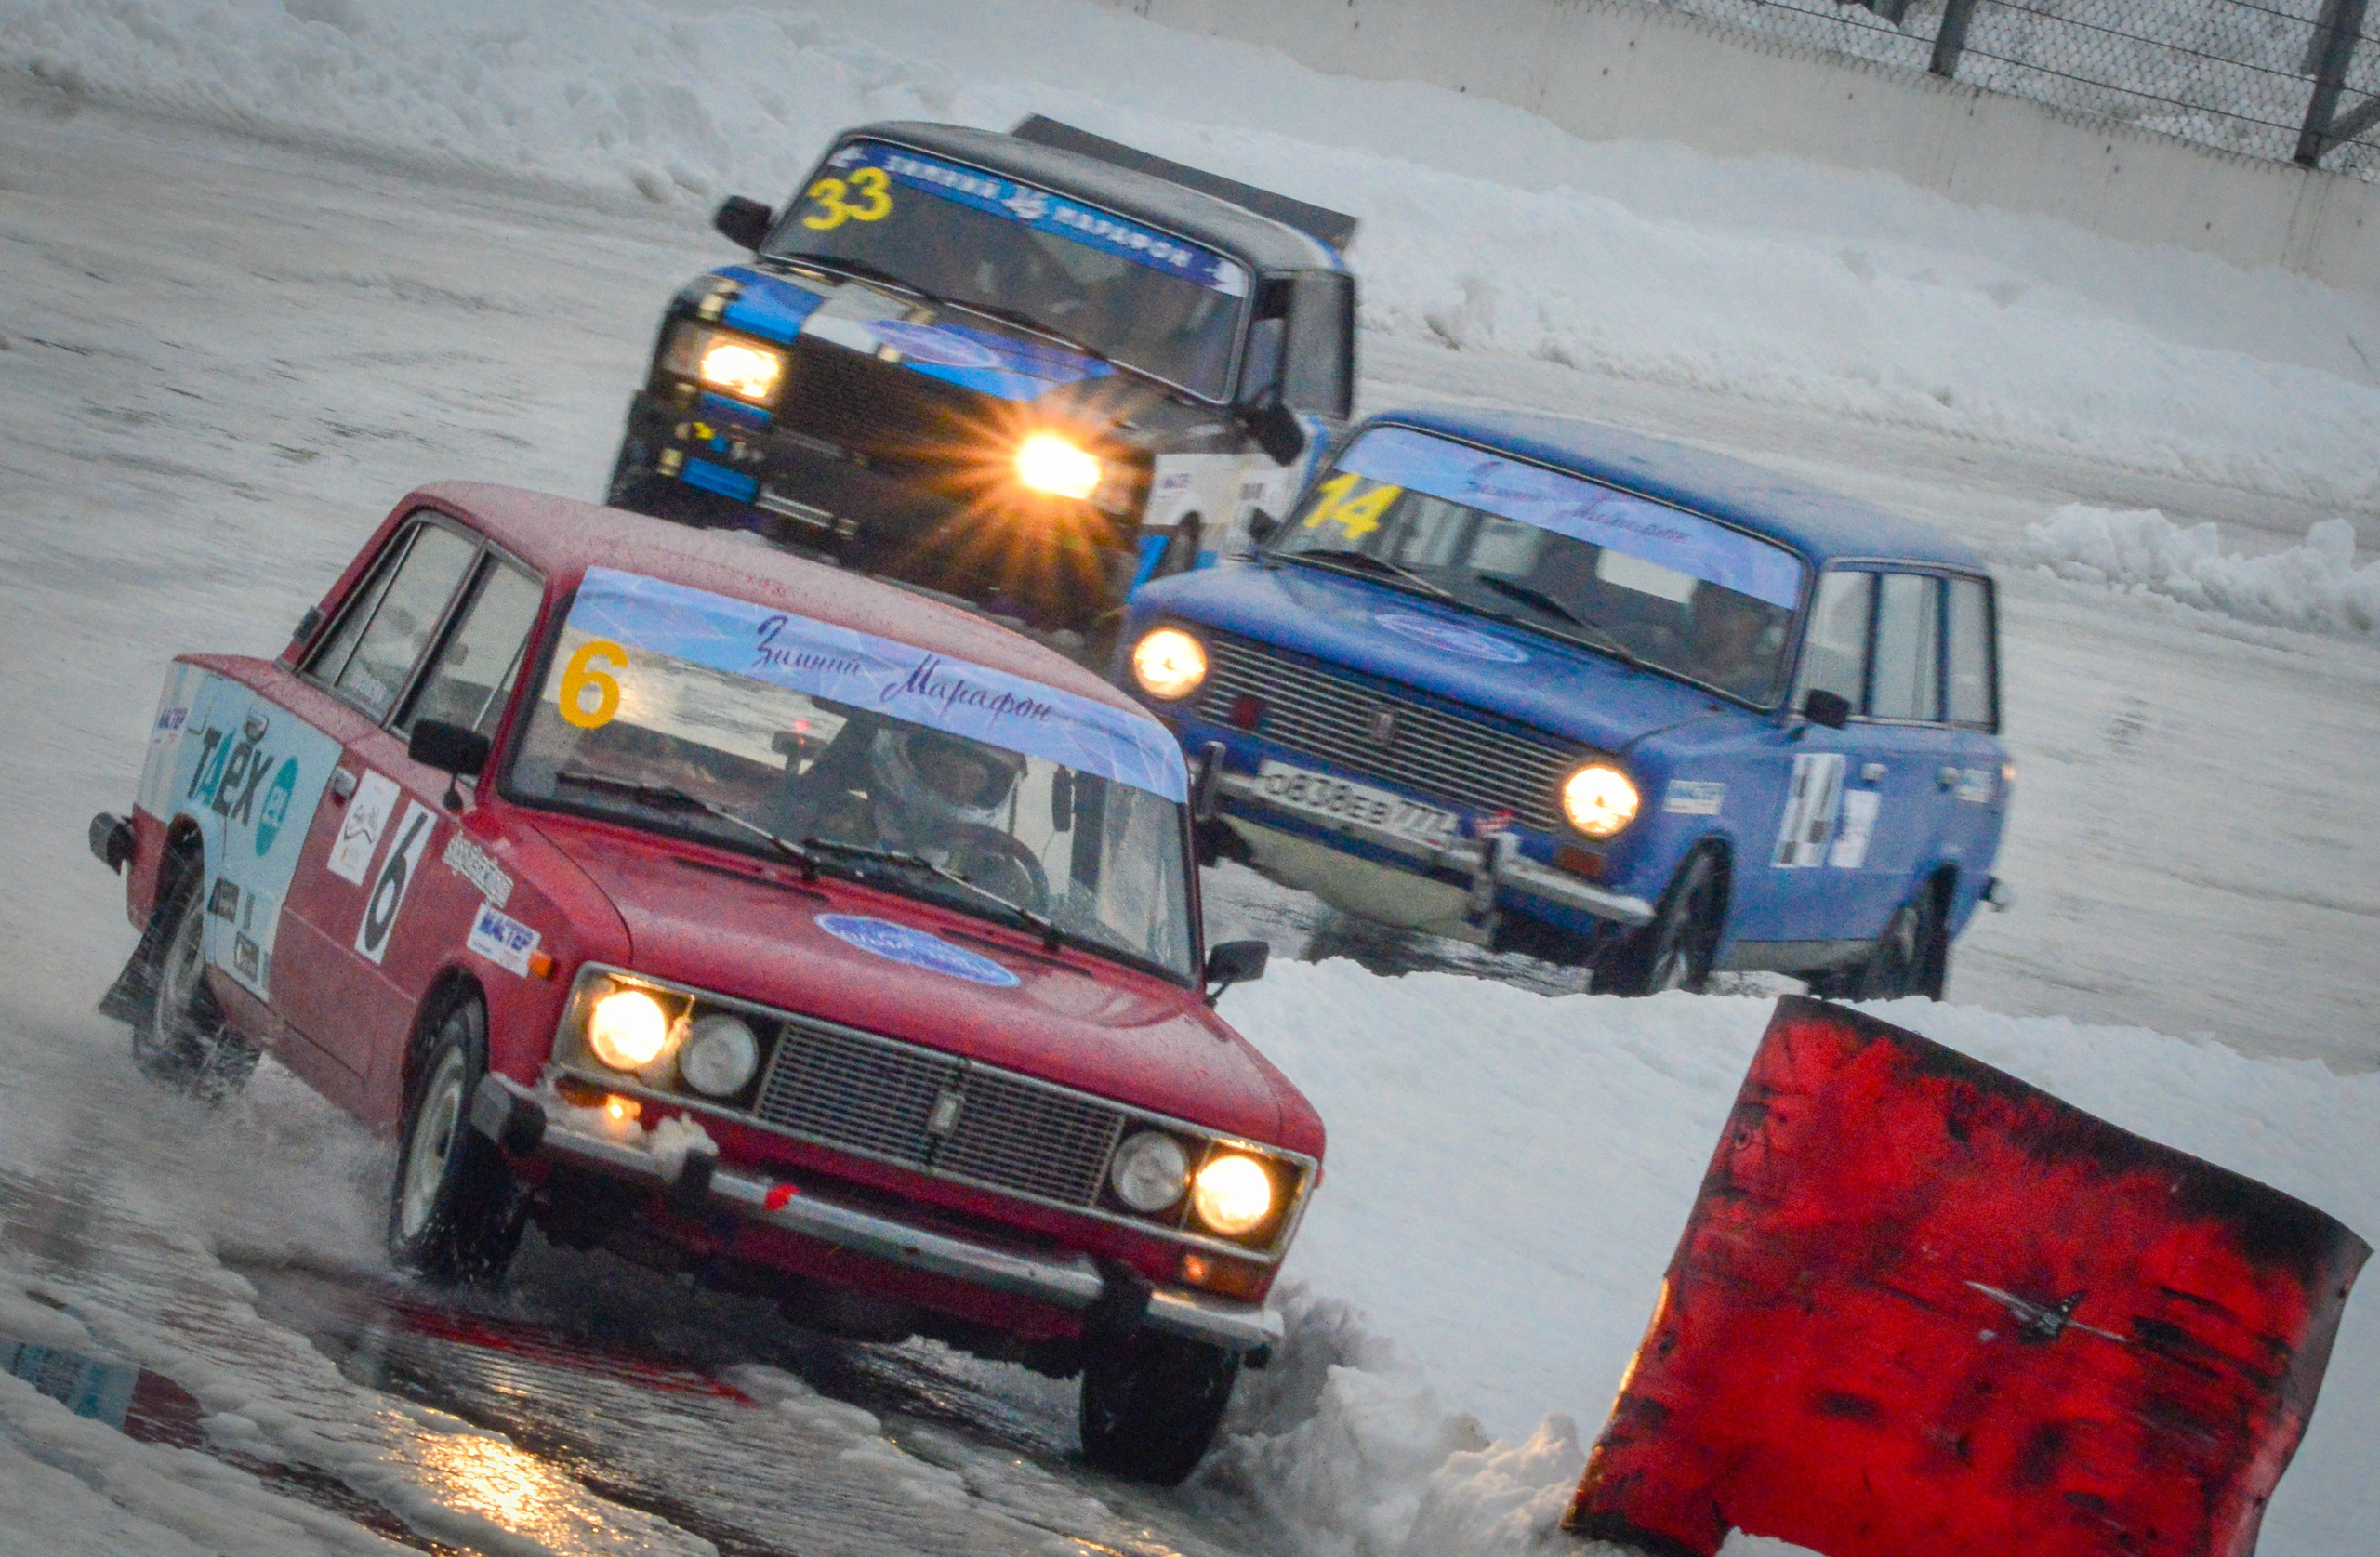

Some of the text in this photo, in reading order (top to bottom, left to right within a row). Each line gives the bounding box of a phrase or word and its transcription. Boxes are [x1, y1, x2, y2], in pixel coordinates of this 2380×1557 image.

[802, 167, 892, 230] 33
[1303, 472, 1404, 539] 14
[560, 640, 628, 729] 6
[751, 615, 1052, 728] Зимний Марафон
[364, 811, 429, 952] 6
